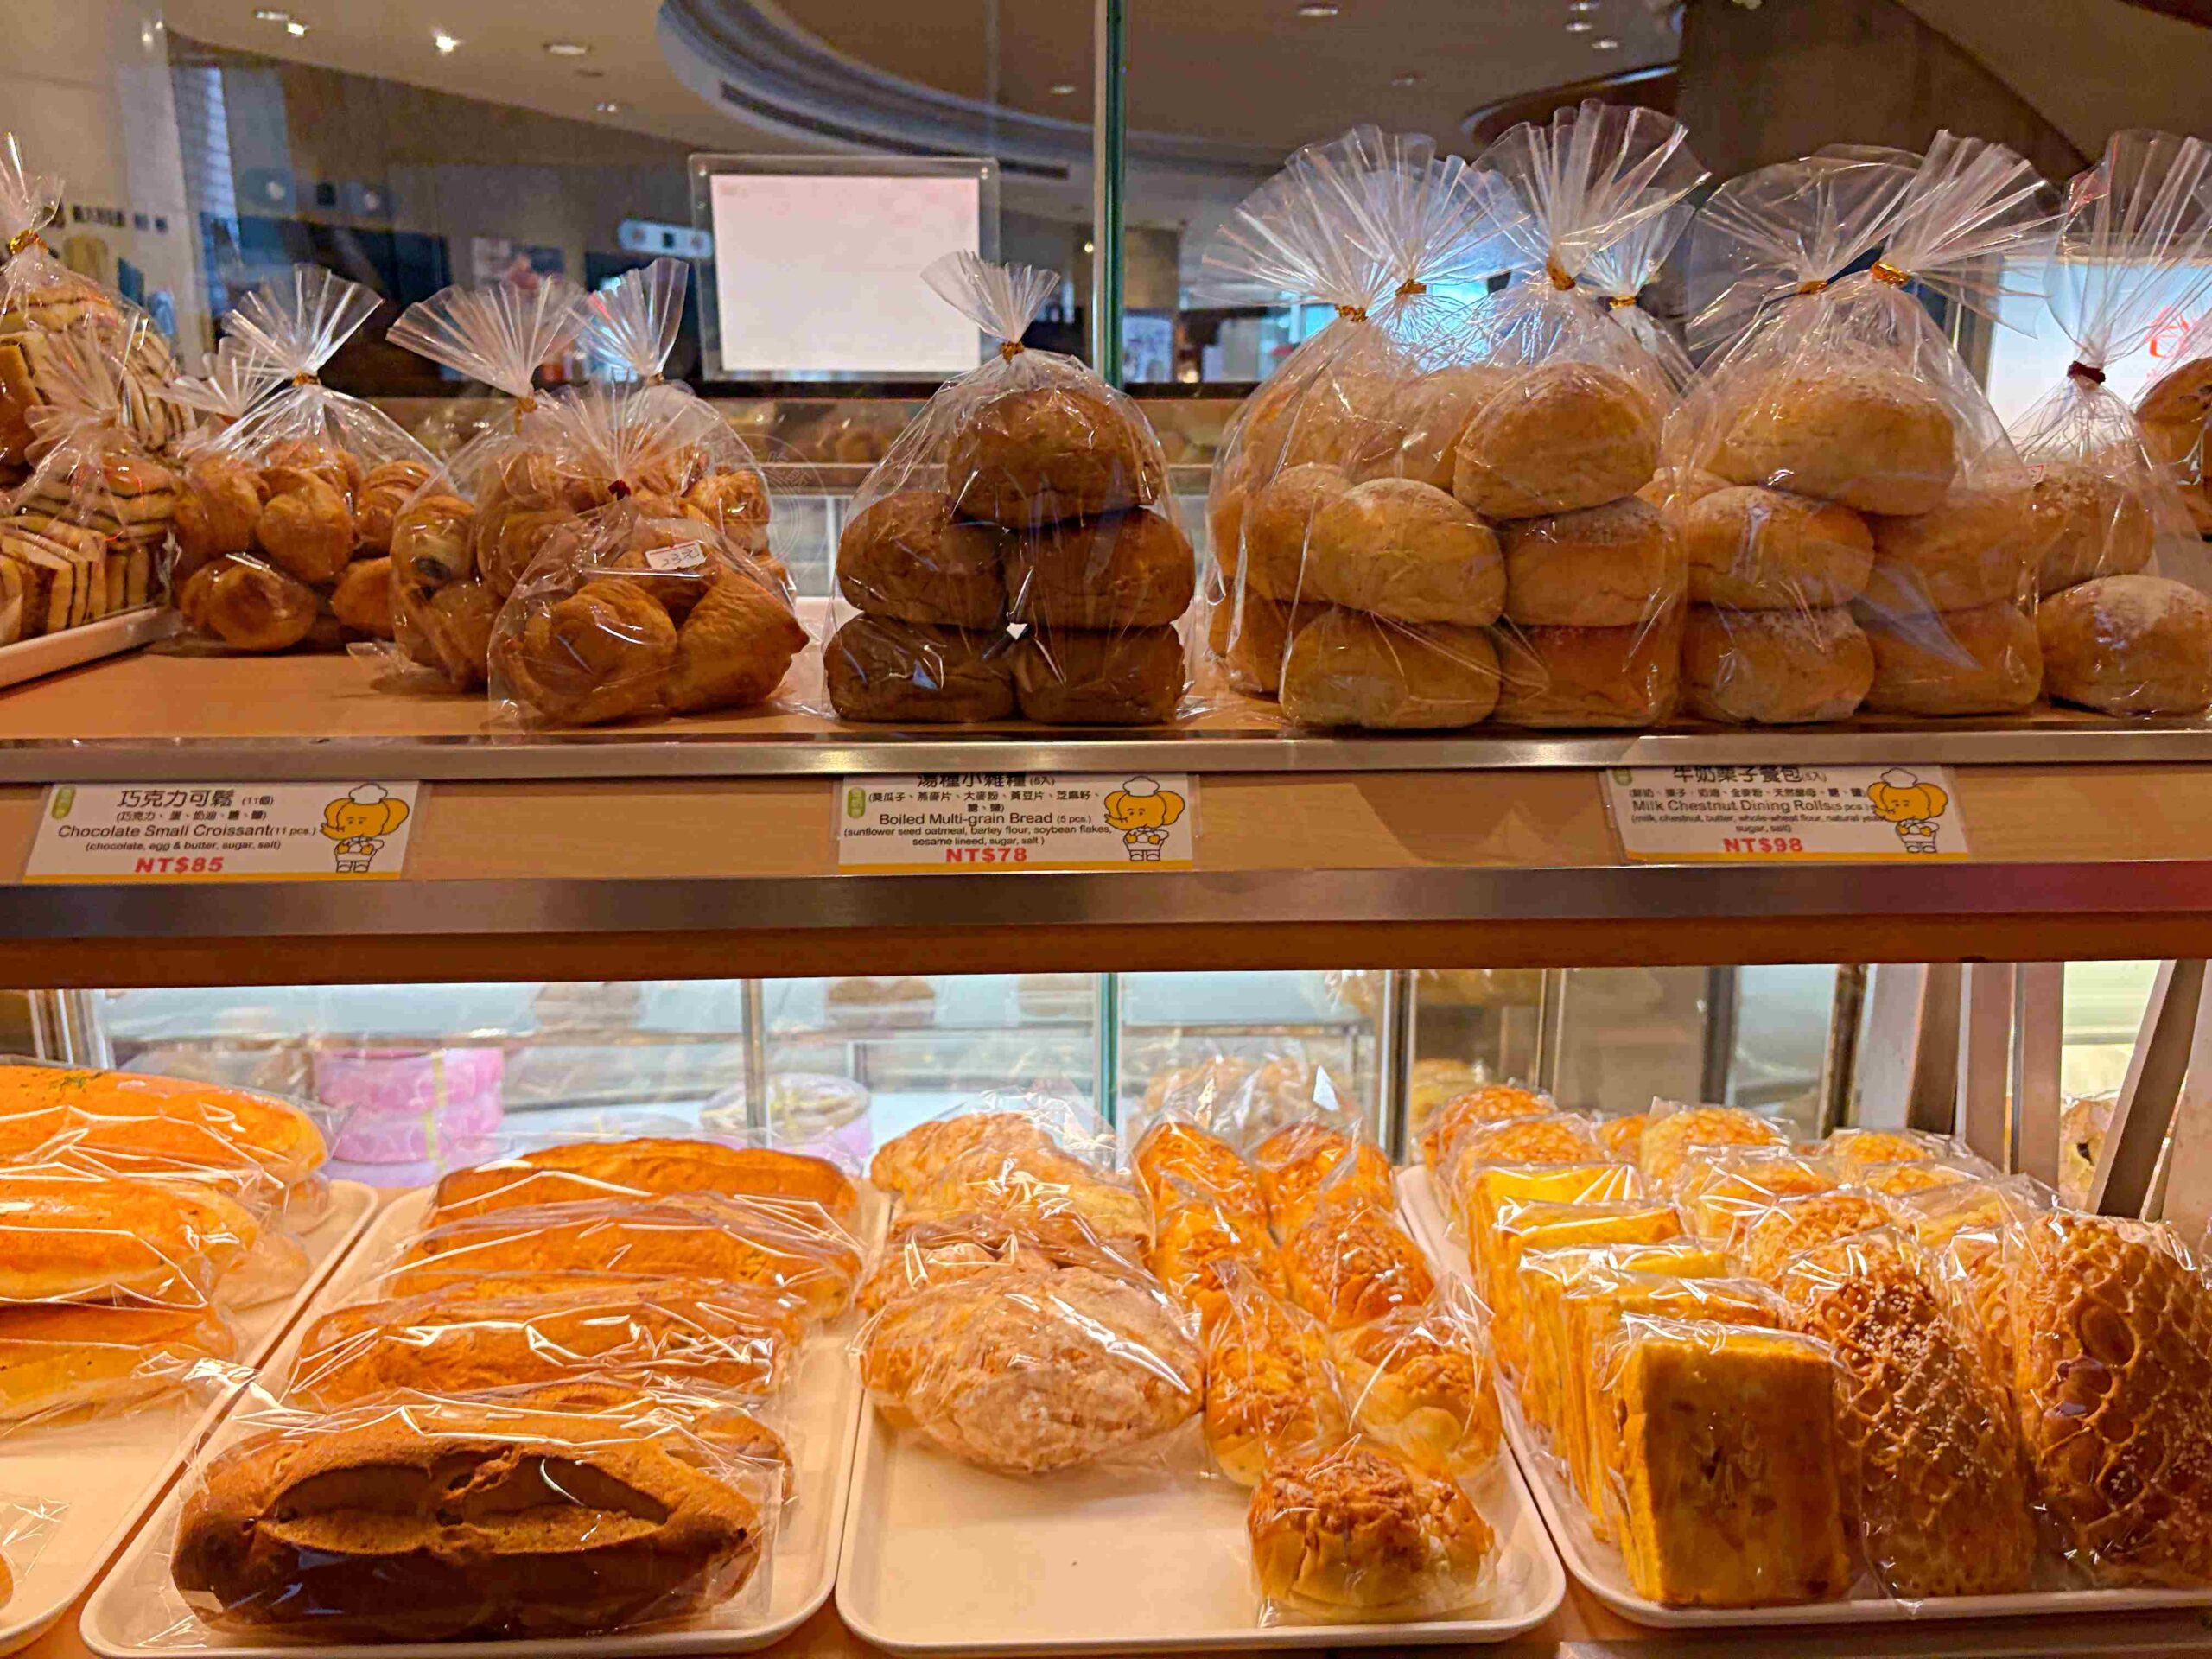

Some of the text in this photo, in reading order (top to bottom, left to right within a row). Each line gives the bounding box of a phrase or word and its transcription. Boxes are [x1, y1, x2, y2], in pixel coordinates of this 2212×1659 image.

[1633, 800, 1663, 811] Milk
[1668, 800, 1738, 811] Chestnut
[1740, 800, 1790, 813] Dining
[880, 814, 925, 825] Boiled
[929, 813, 1005, 827] Multi-grain
[1009, 812, 1052, 823] Bread
[58, 824, 140, 838] Chocolate
[144, 824, 188, 837] Small
[1033, 825, 1077, 836] soybean
[149, 842, 170, 852] egg
[1723, 837, 1803, 852] NT$98
[946, 847, 1027, 862] NT$78
[135, 856, 225, 873] NT$85
